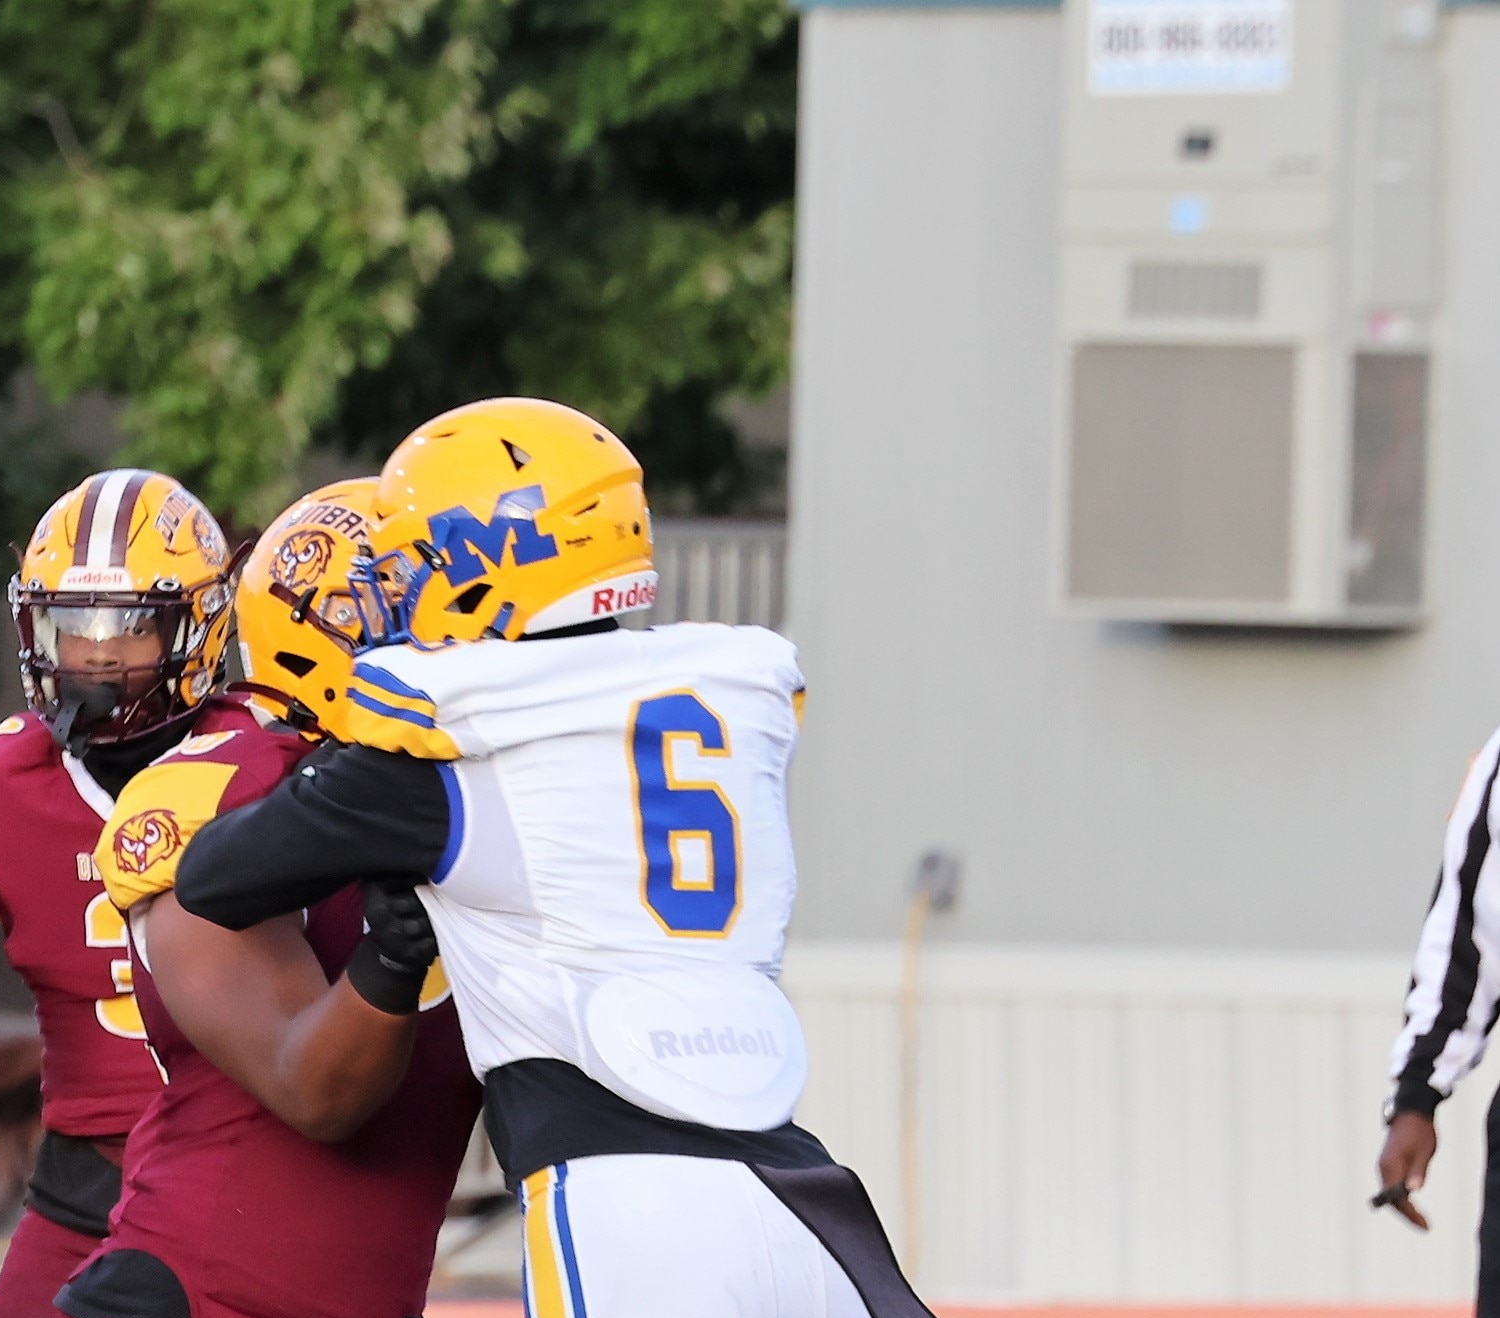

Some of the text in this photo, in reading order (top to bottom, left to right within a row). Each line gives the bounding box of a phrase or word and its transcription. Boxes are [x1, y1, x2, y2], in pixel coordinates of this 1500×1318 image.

[427, 484, 560, 588] M
[626, 687, 742, 940] 6
[647, 1026, 784, 1060] Riddell
